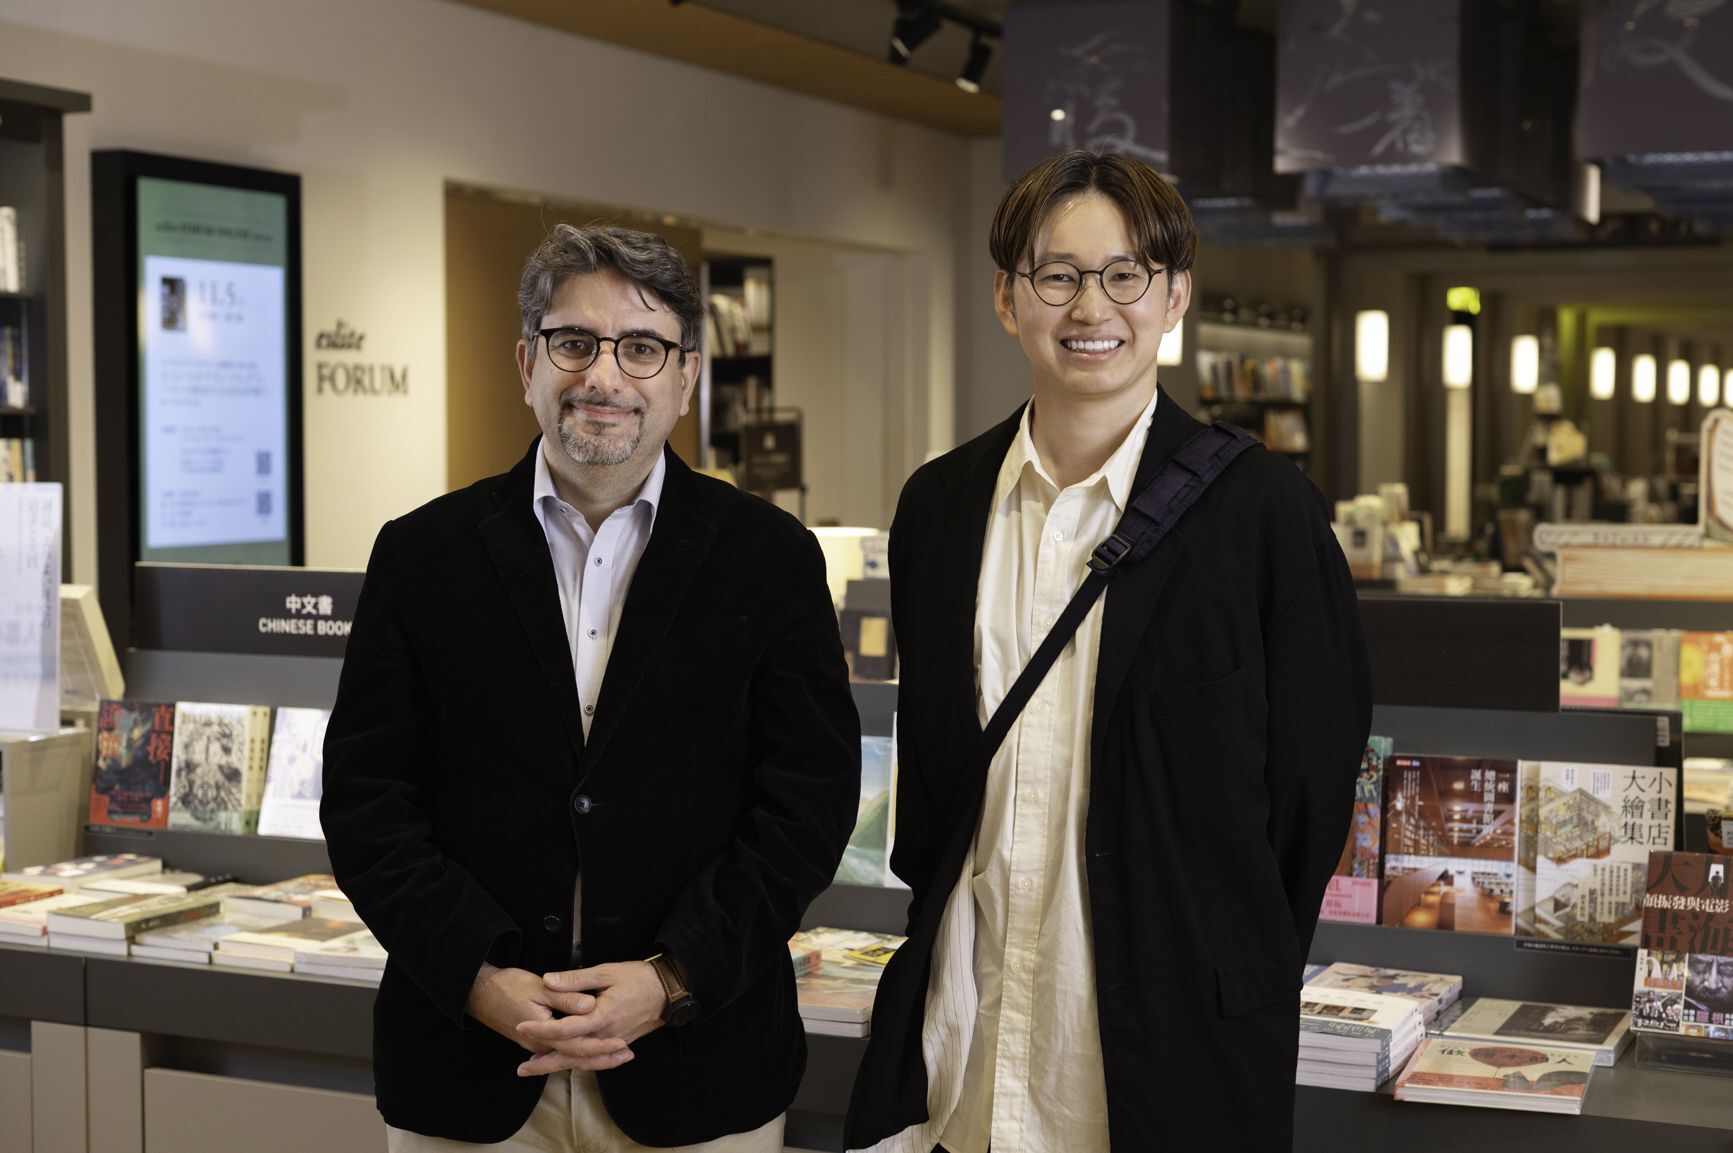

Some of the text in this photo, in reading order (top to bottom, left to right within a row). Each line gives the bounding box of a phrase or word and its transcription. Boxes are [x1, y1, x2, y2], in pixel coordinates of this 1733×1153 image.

[316, 362, 409, 397] FORUM
[285, 593, 333, 616] 中文書
[259, 618, 315, 635] CHINESE
[1620, 769, 1647, 846] 大繪集
[1647, 770, 1674, 847] 小書店
